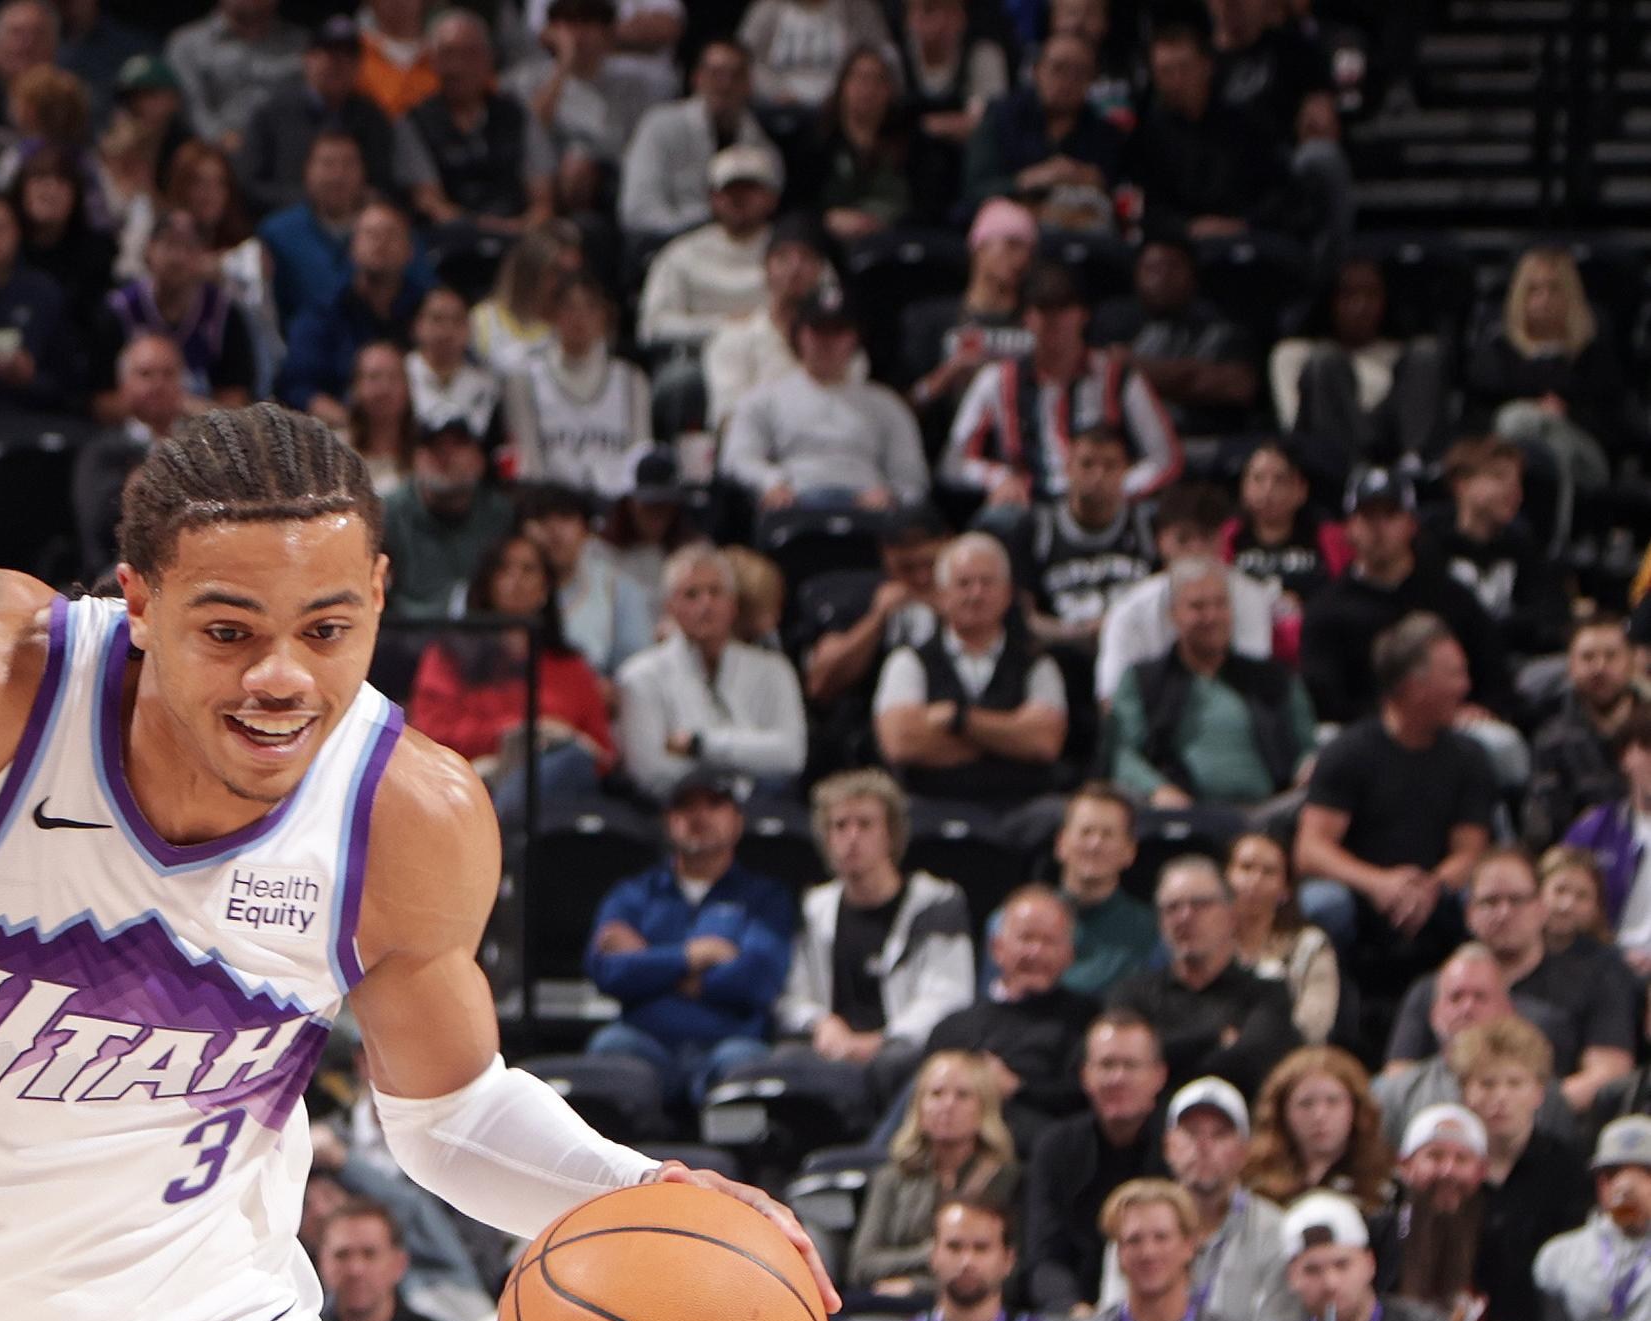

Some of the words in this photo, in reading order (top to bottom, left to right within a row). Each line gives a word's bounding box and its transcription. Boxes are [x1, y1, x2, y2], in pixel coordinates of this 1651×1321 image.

[230, 869, 320, 902] Health
[226, 897, 316, 934] Equity
[162, 1105, 248, 1205] 3
